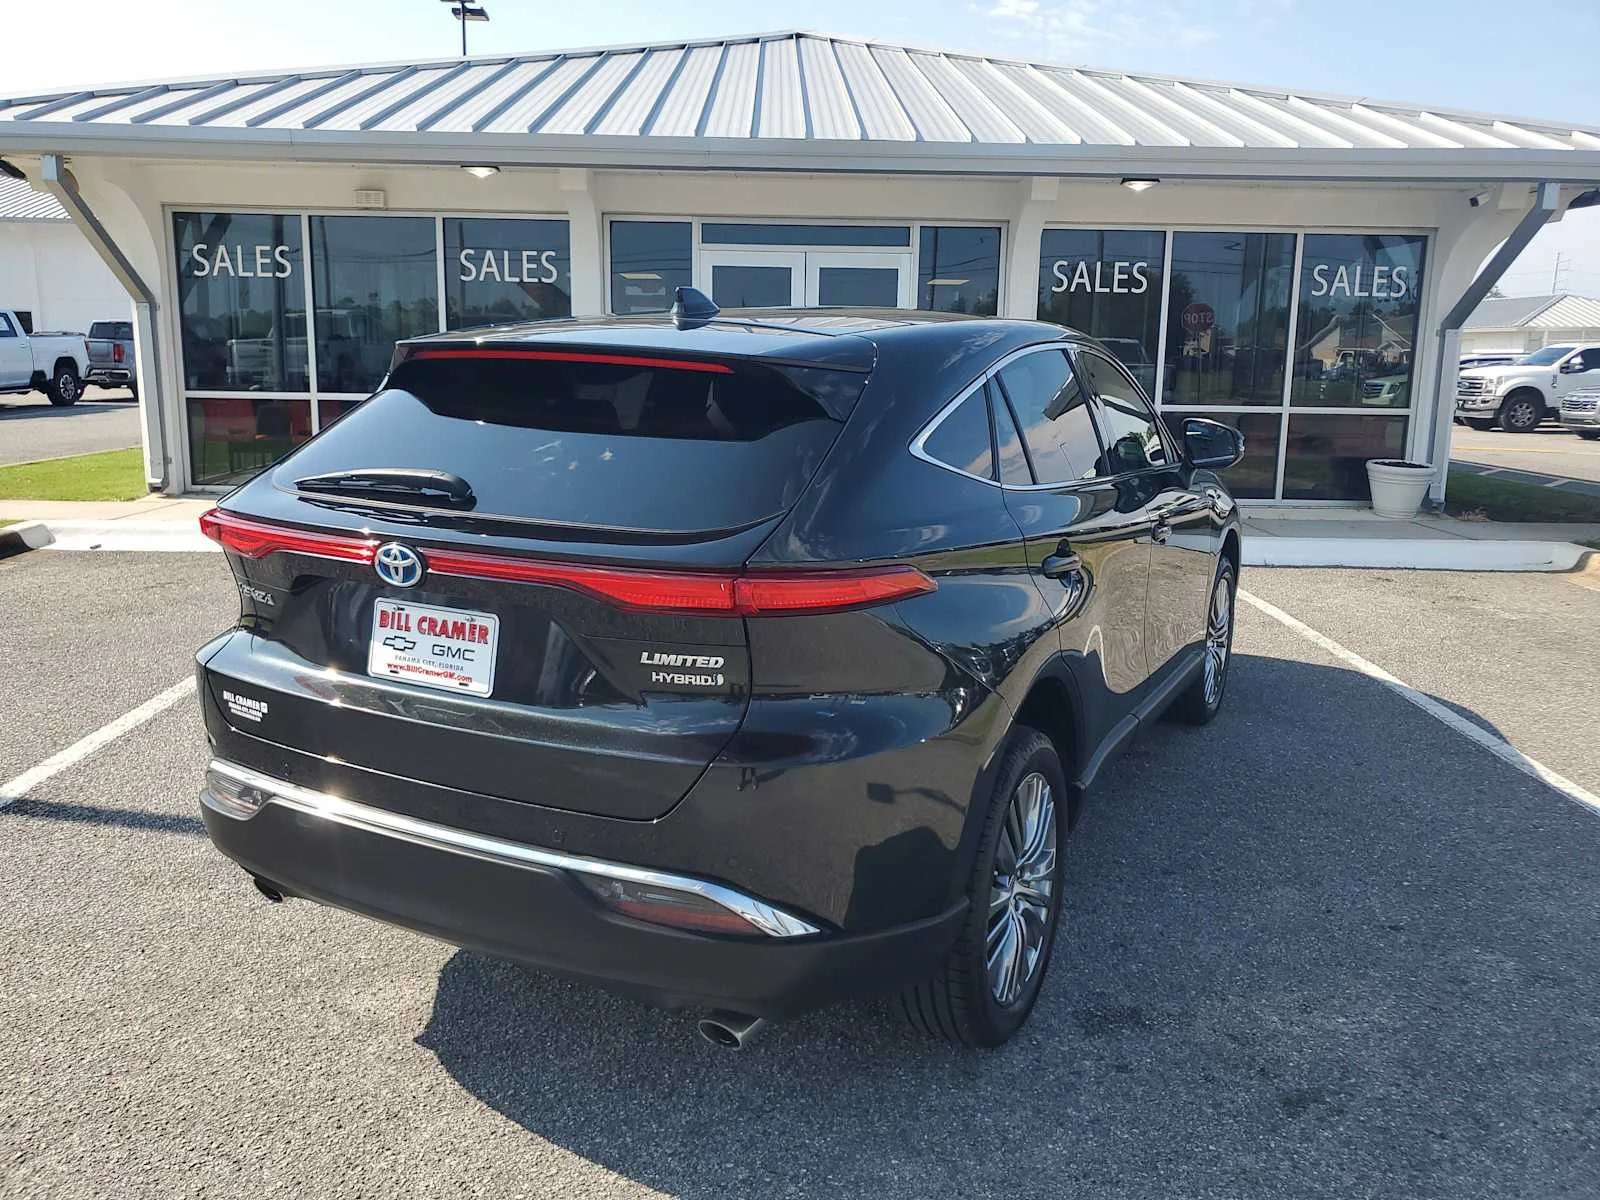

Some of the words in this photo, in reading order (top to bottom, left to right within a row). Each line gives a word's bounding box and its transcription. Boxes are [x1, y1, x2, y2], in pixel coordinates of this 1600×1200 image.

[192, 243, 292, 278] SALES
[460, 248, 558, 283] SALES
[1051, 260, 1149, 294] SALES
[1311, 264, 1408, 299] SALES
[379, 610, 411, 632] BILL
[417, 616, 489, 644] CRAMER
[394, 654, 421, 664] PANAMA
[432, 644, 475, 661] GMC
[640, 651, 725, 668] LIMITED
[651, 671, 713, 686] HYBRID
